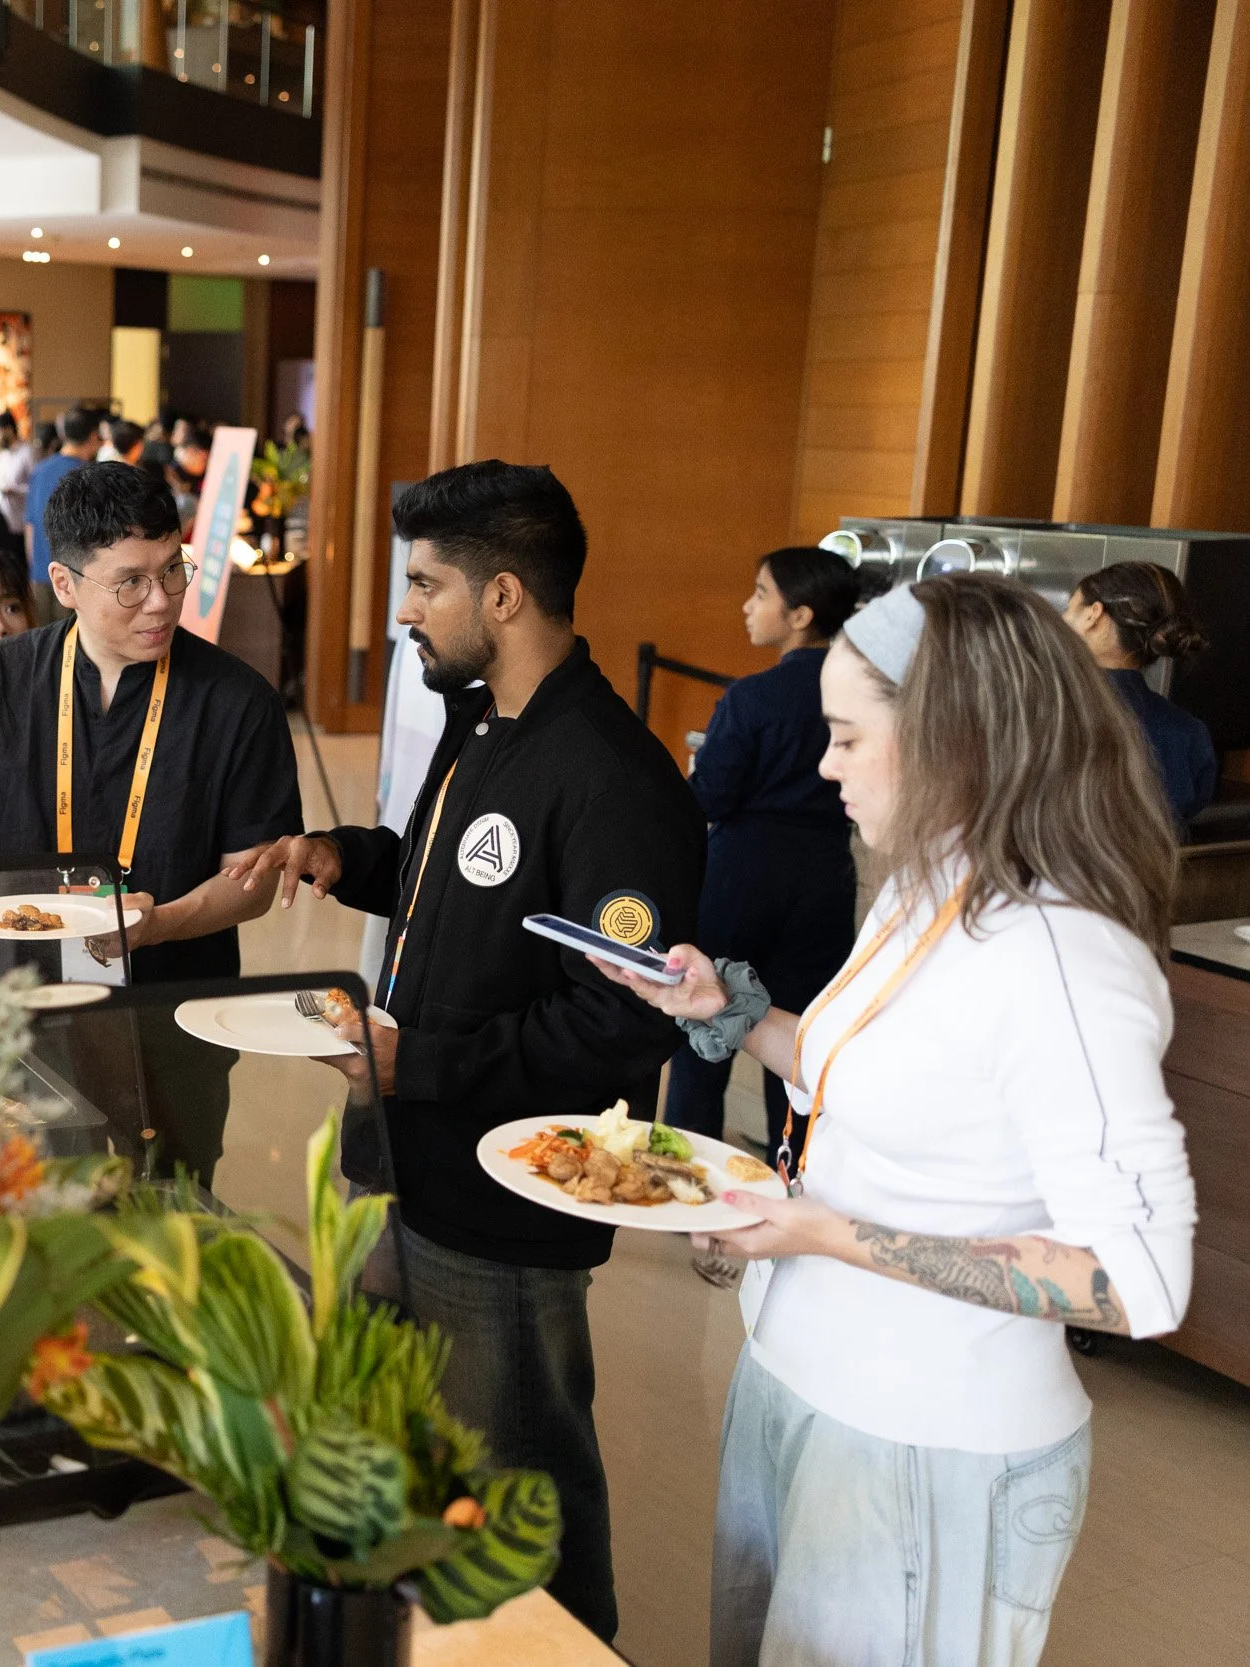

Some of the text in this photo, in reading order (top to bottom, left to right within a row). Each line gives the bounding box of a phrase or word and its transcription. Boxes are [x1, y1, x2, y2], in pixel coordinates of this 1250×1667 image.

[64, 645, 73, 668] Figma
[62, 693, 70, 717] Figma
[150, 698, 161, 723] Figma
[60, 742, 69, 766] Figma
[140, 747, 151, 770] Figma
[59, 791, 68, 815] Figma
[130, 795, 141, 819] Figma
[464, 864, 496, 882] ALT BEING
